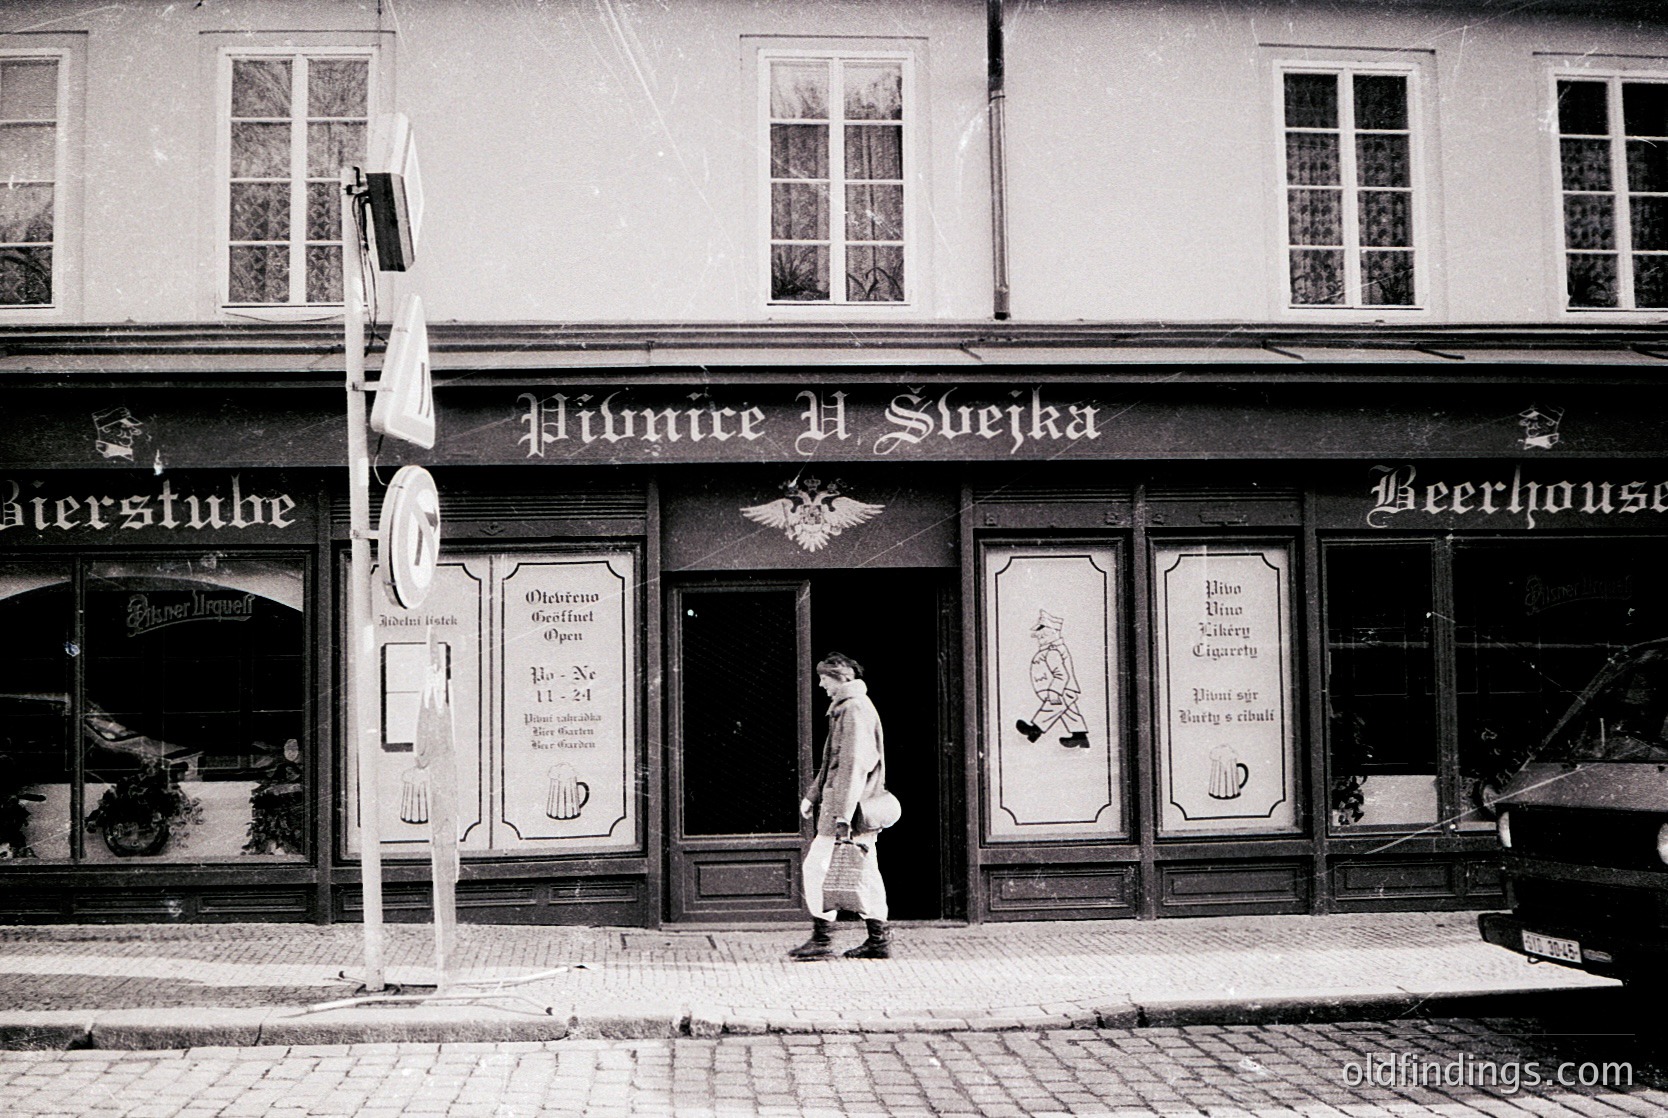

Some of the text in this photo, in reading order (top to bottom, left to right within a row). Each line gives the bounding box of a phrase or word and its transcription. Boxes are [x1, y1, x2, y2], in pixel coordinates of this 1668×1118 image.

[517, 384, 1102, 458] Pivnice U Švejka
[0, 474, 297, 530] Bierstube
[1366, 464, 1668, 529] Beerhouse
[525, 589, 600, 604] Otevřeno
[1206, 580, 1242, 599] Pivo
[126, 588, 256, 638] Pilsner Urquell
[531, 610, 594, 623] Geöffnet
[543, 628, 583, 644] Open
[1199, 622, 1250, 639] Likéry
[1192, 643, 1258, 661] Cigarety
[530, 666, 554, 684] Po
[572, 665, 596, 681] Ne
[537, 690, 553, 703] 11
[573, 688, 591, 701] 24
[1225, 714, 1233, 723] s
[532, 726, 594, 737] Bier Garten
[531, 739, 596, 750] Beer Garden
